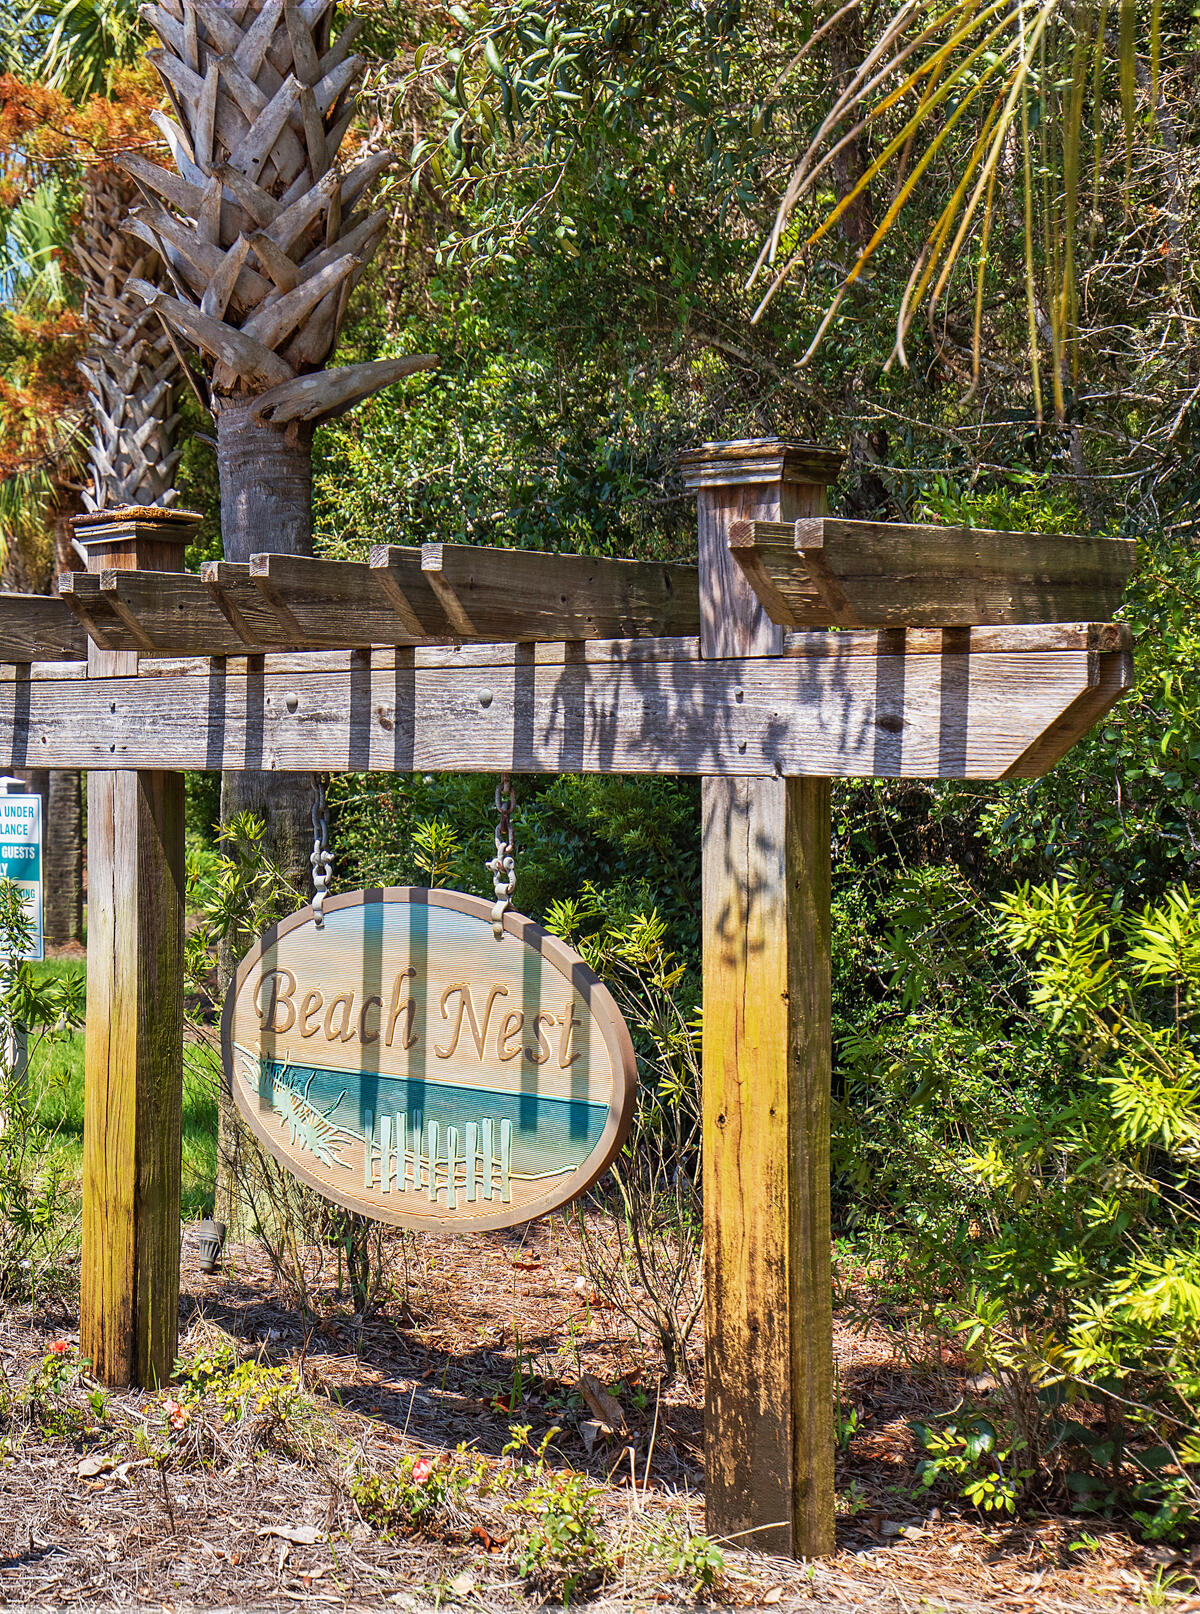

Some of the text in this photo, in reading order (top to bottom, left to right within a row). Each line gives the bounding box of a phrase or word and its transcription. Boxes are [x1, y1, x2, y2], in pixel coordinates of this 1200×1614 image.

[4, 806, 34, 818] UNDER
[1, 846, 35, 859] GUESTS
[253, 966, 581, 1068] Beach Nest
